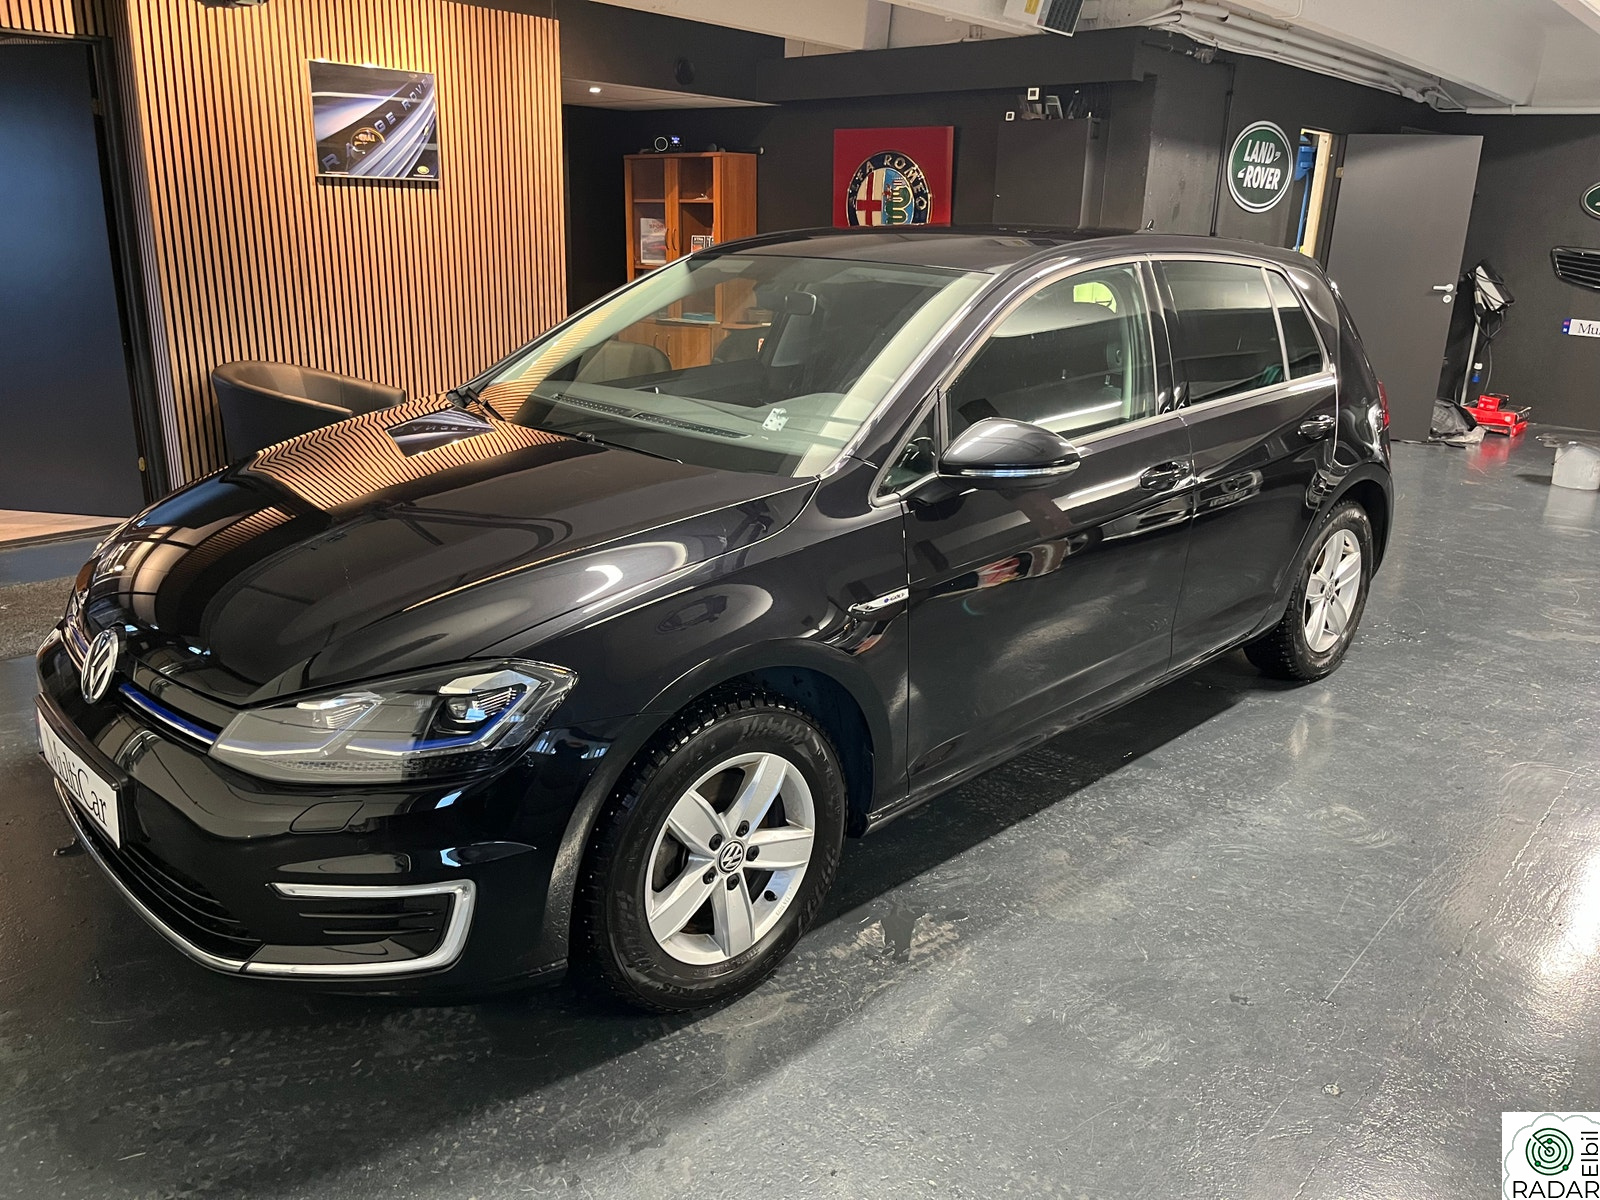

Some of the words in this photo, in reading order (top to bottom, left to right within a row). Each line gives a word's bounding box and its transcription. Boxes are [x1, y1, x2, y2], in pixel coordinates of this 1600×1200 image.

[1243, 139, 1276, 164] LAND
[883, 154, 927, 210] ROMEO
[1243, 165, 1281, 190] ROVER
[44, 727, 107, 827] MultiCar
